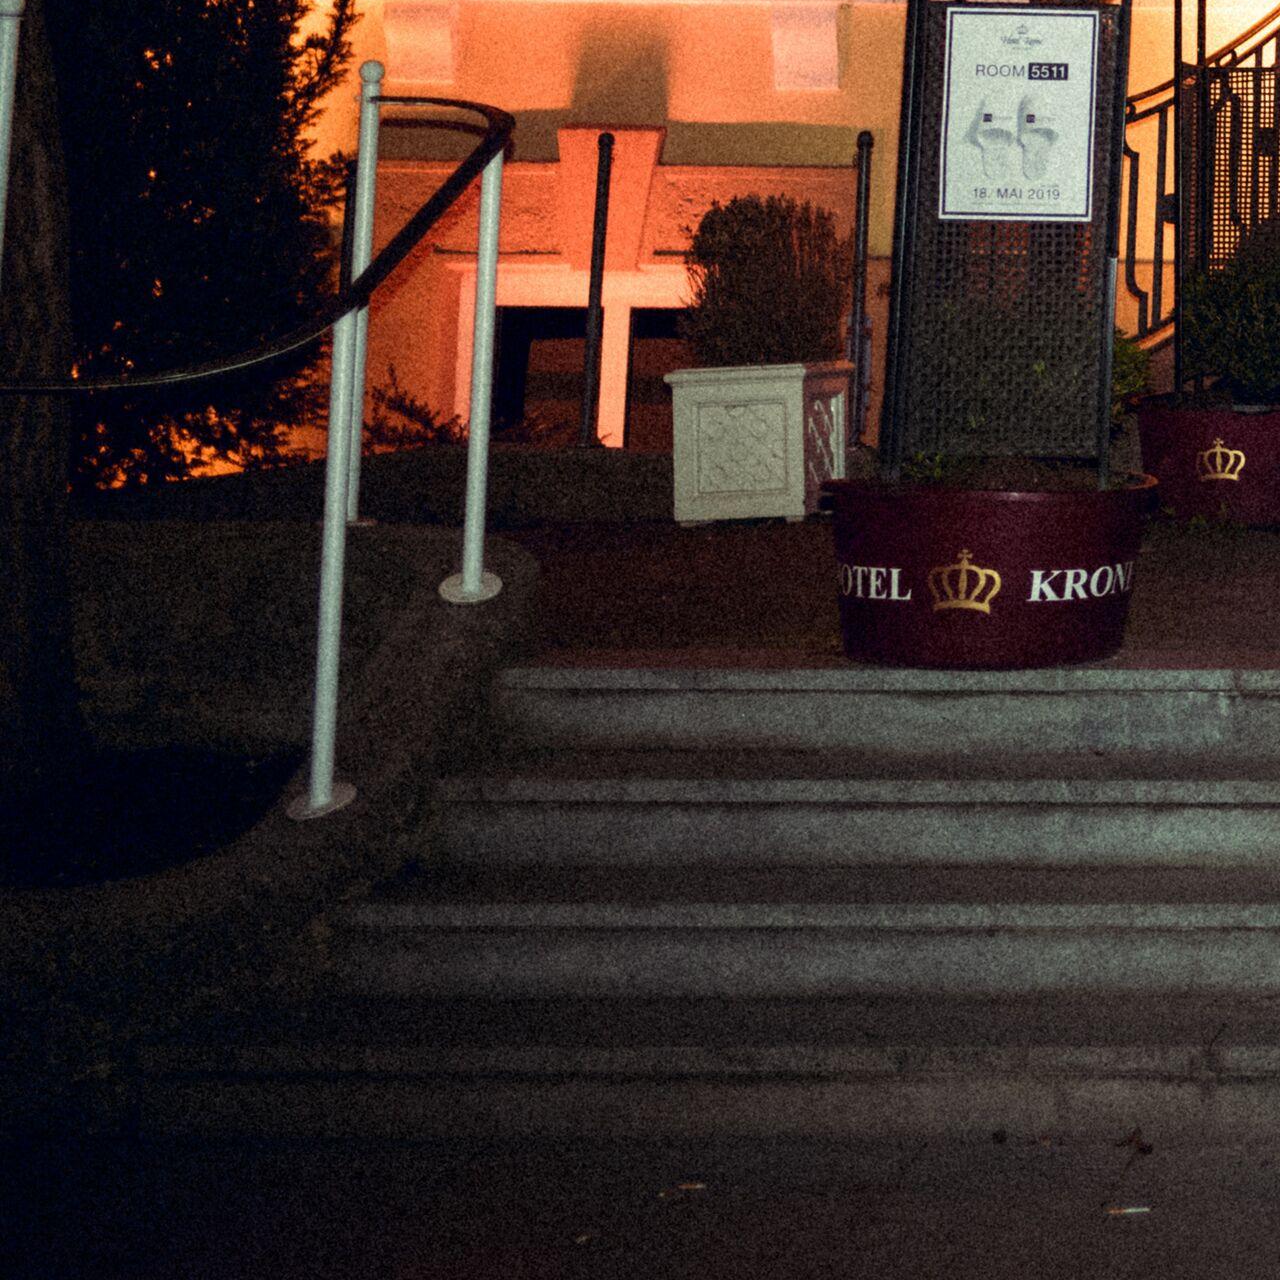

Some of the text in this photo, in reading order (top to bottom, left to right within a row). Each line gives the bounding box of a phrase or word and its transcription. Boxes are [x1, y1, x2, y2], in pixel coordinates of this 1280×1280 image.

[975, 64, 1066, 78] ROOM 5511
[973, 187, 1060, 200] 18. MAI 2019
